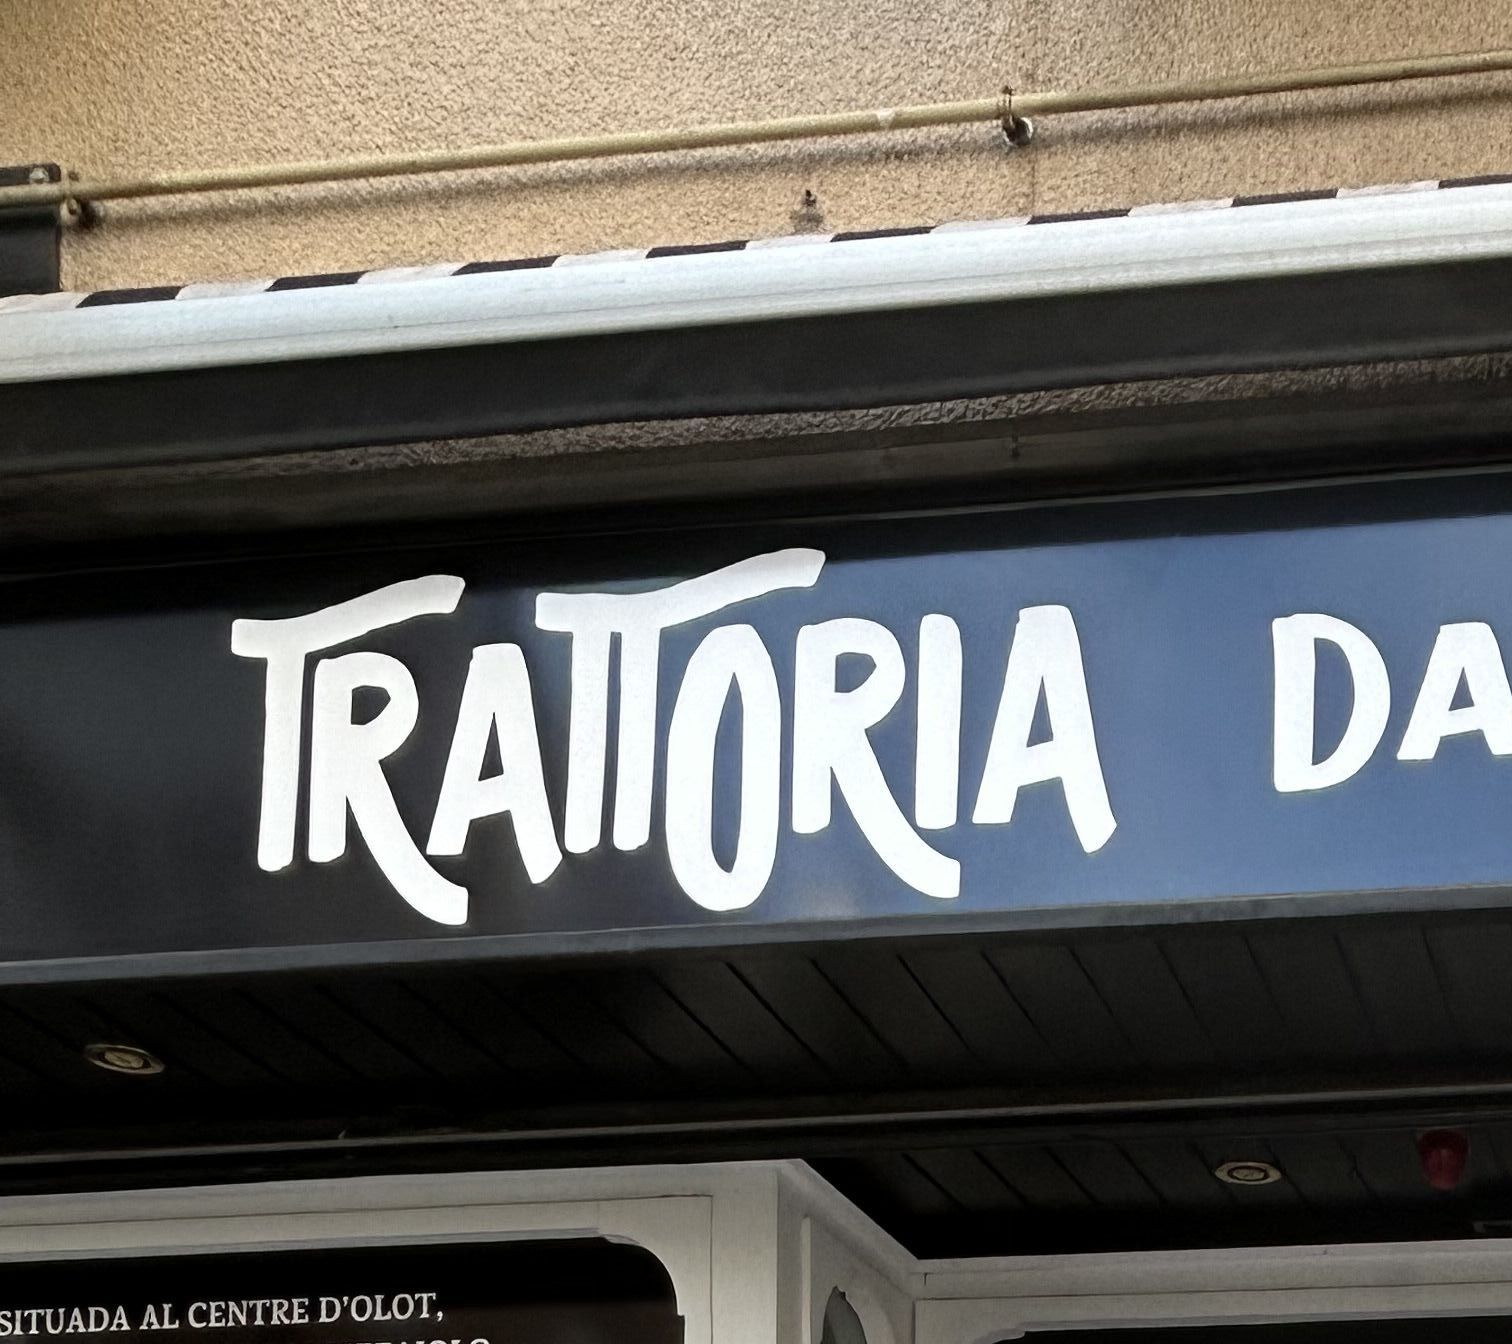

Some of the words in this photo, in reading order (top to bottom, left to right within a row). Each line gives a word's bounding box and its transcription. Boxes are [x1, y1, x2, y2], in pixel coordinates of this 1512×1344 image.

[231, 547, 1118, 926] TRATTORIA
[0, 1305, 131, 1337] SITUADA
[138, 1303, 180, 1331] AL
[187, 1297, 309, 1330] CENTRE
[318, 1293, 445, 1324] D'OLOT,
